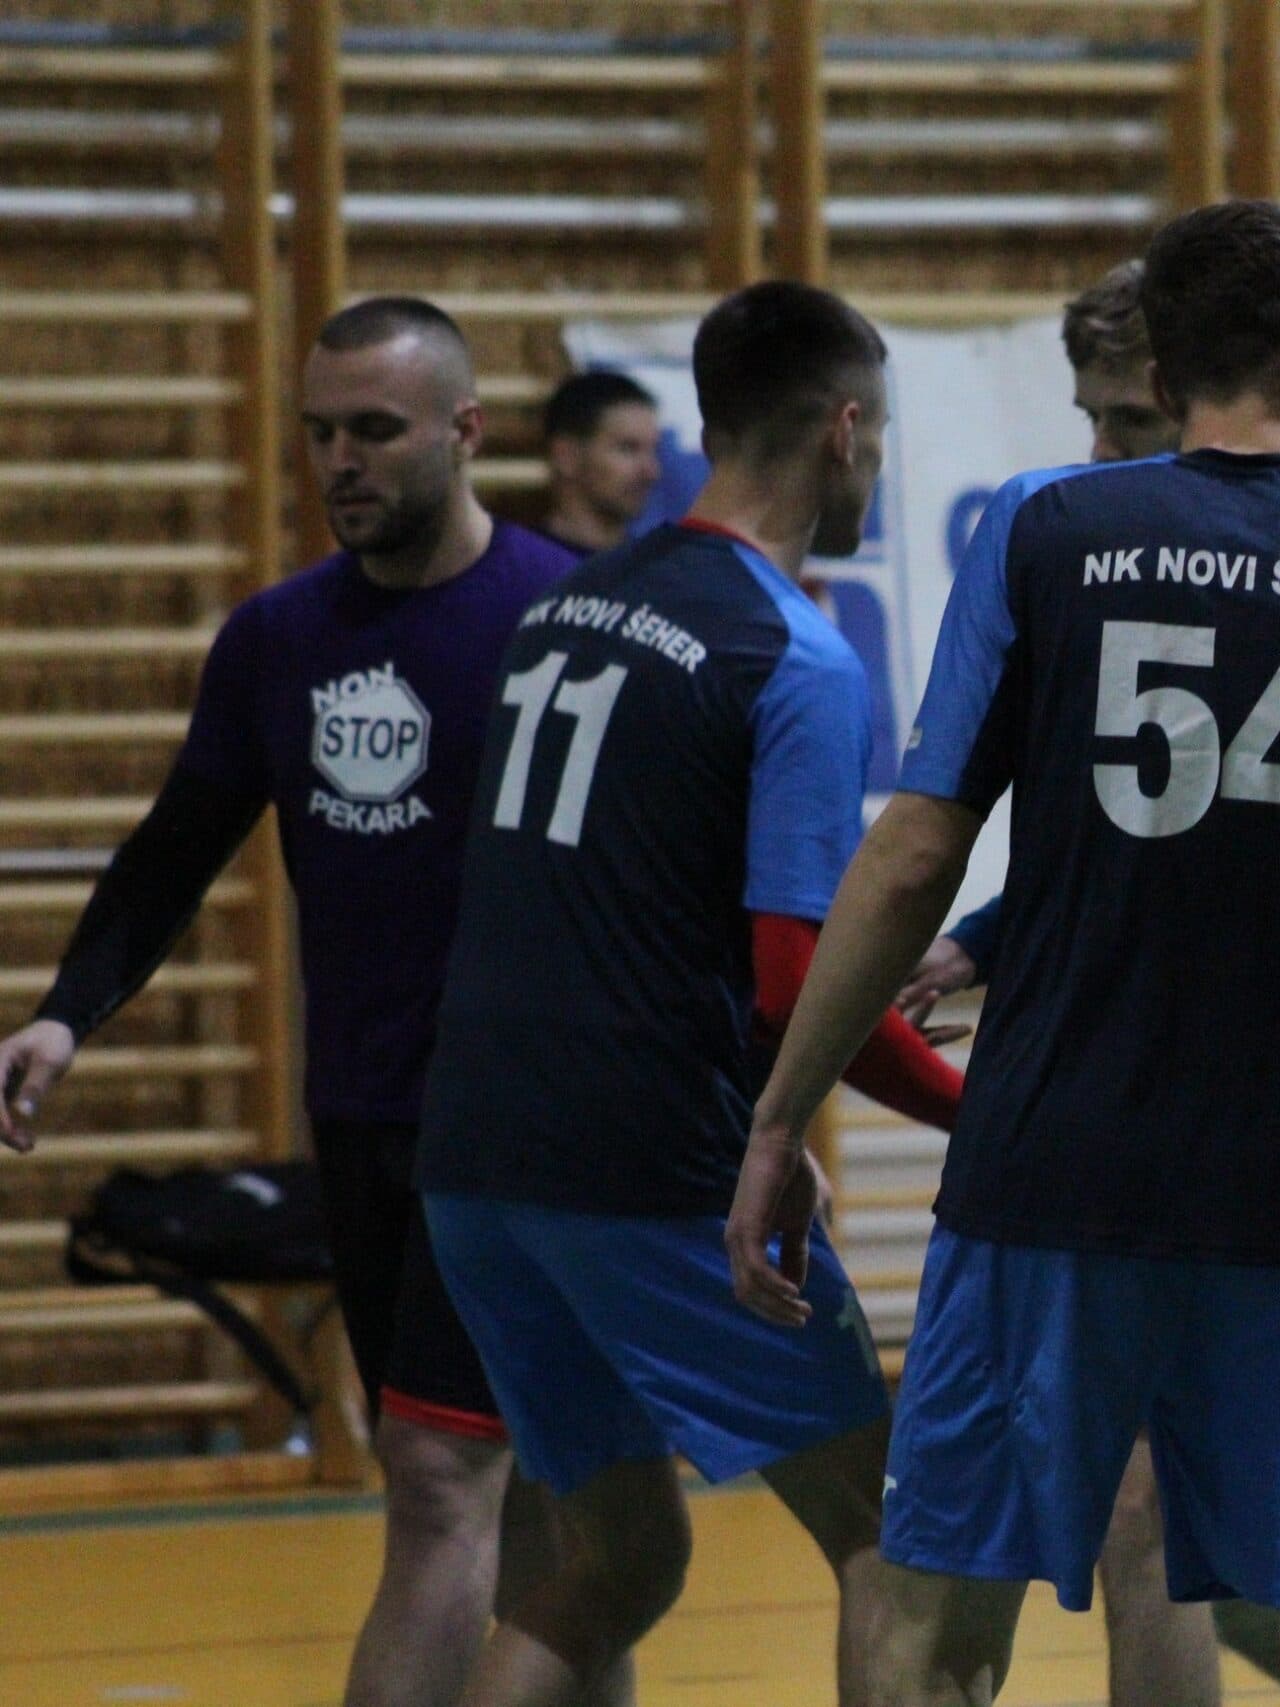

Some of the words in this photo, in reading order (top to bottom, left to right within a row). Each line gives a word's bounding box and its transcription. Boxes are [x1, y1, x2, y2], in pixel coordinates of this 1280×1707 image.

[1083, 548, 1145, 586] NK
[1156, 547, 1257, 592] NOVI
[553, 594, 627, 632] NOVI
[621, 603, 708, 674] ŠEHER
[310, 661, 394, 713] NON
[323, 715, 419, 760] STOP
[493, 650, 629, 848] 11
[308, 790, 432, 835] PEKARA
